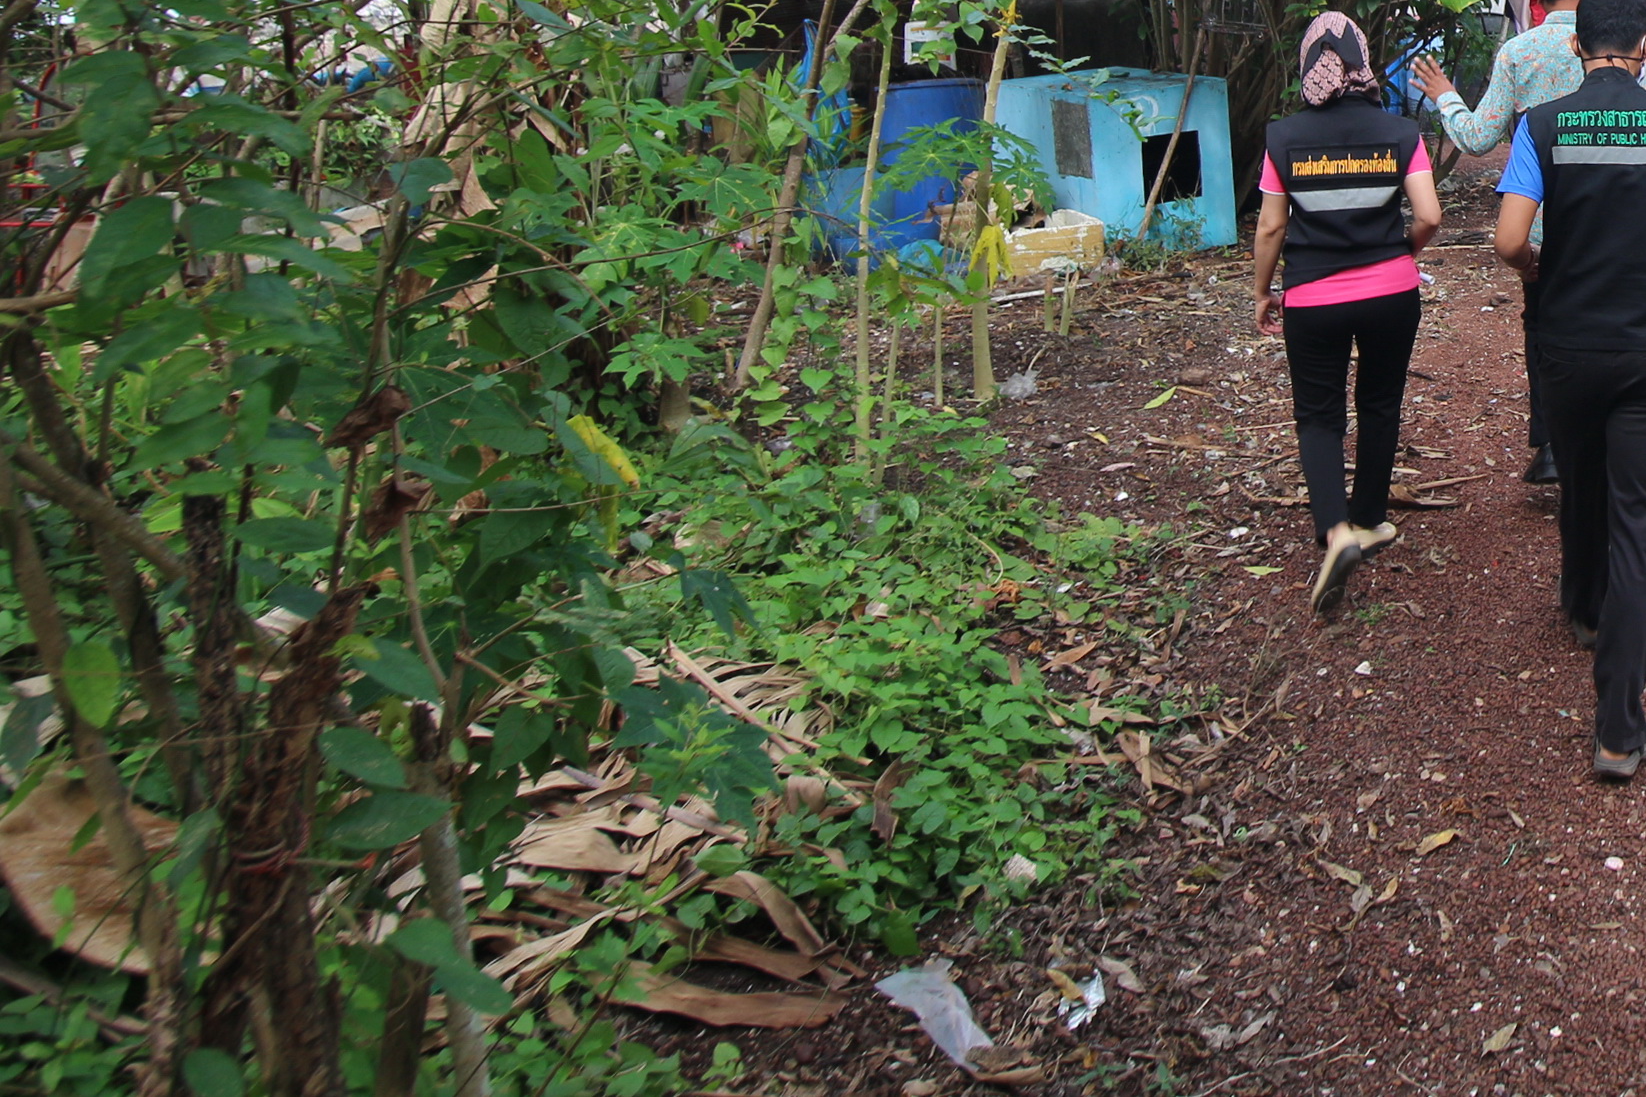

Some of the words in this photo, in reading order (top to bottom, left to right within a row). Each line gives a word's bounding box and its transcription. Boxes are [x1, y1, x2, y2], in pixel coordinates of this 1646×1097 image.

[1557, 133, 1593, 145] MINISTRY
[1596, 133, 1608, 145] OF
[1610, 133, 1638, 145] PUBLIC
